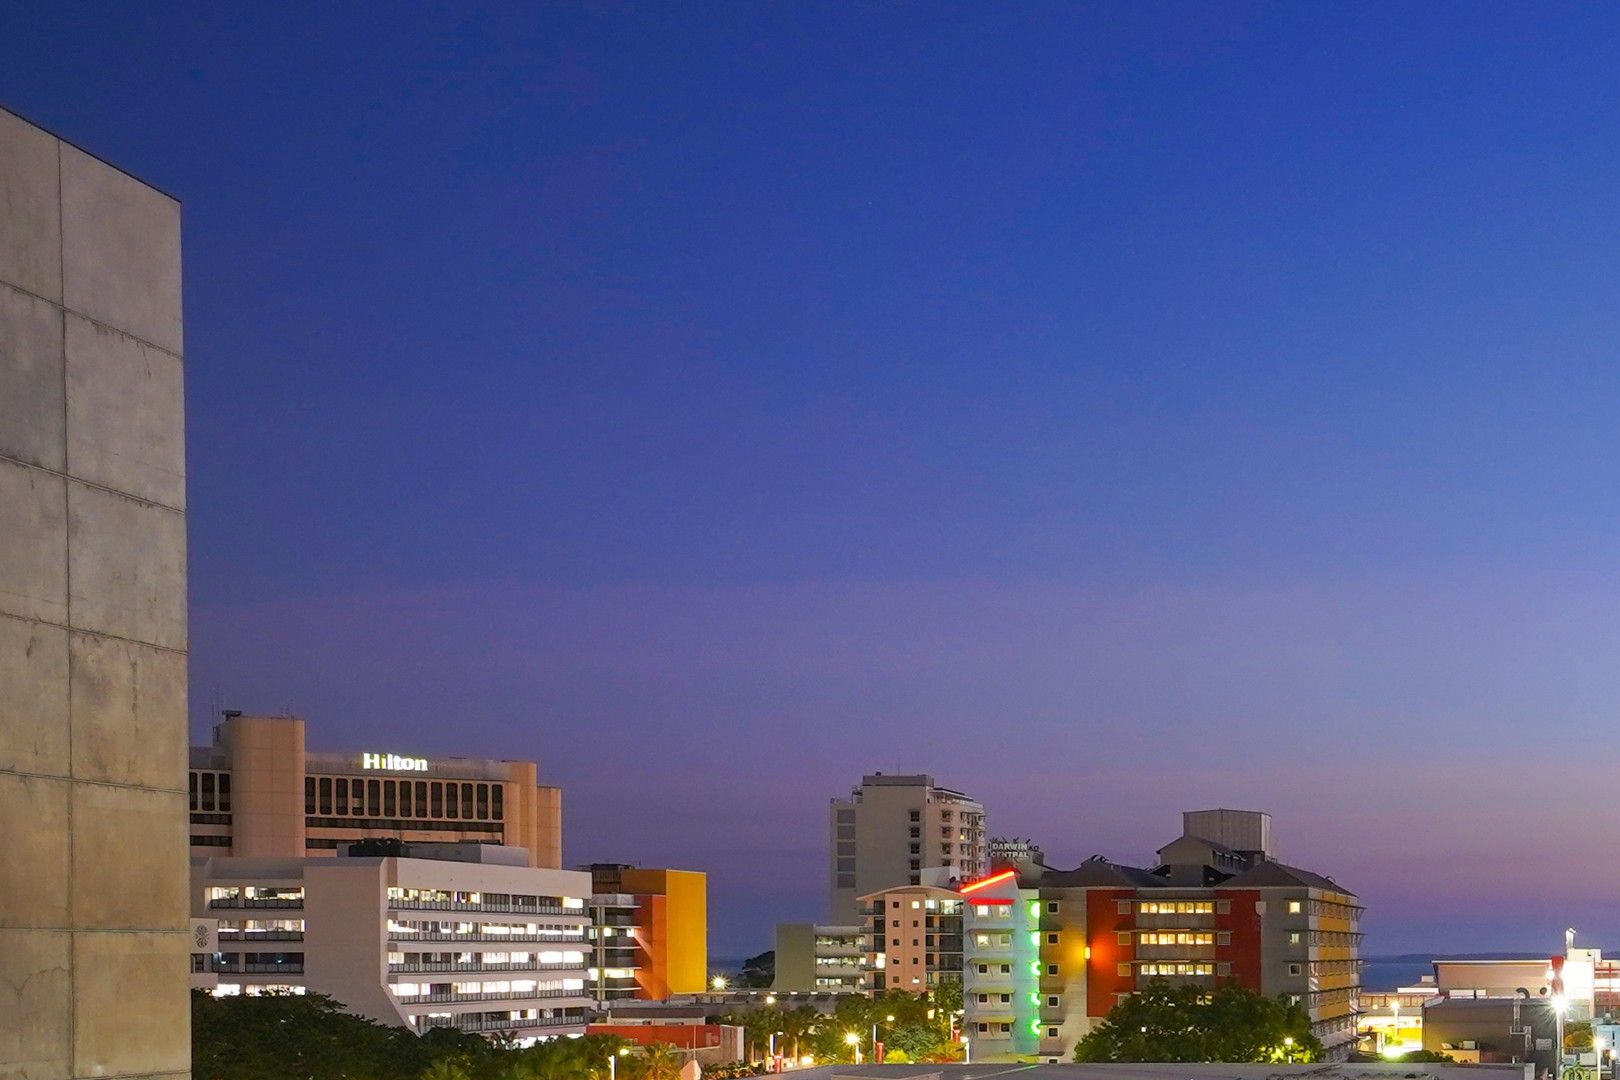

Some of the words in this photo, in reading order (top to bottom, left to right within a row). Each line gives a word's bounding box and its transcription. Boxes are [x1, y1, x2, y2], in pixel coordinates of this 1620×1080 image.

[363, 752, 428, 771] Hilton
[992, 842, 1028, 850] DARWIN
[990, 850, 1029, 858] CENTRAL
